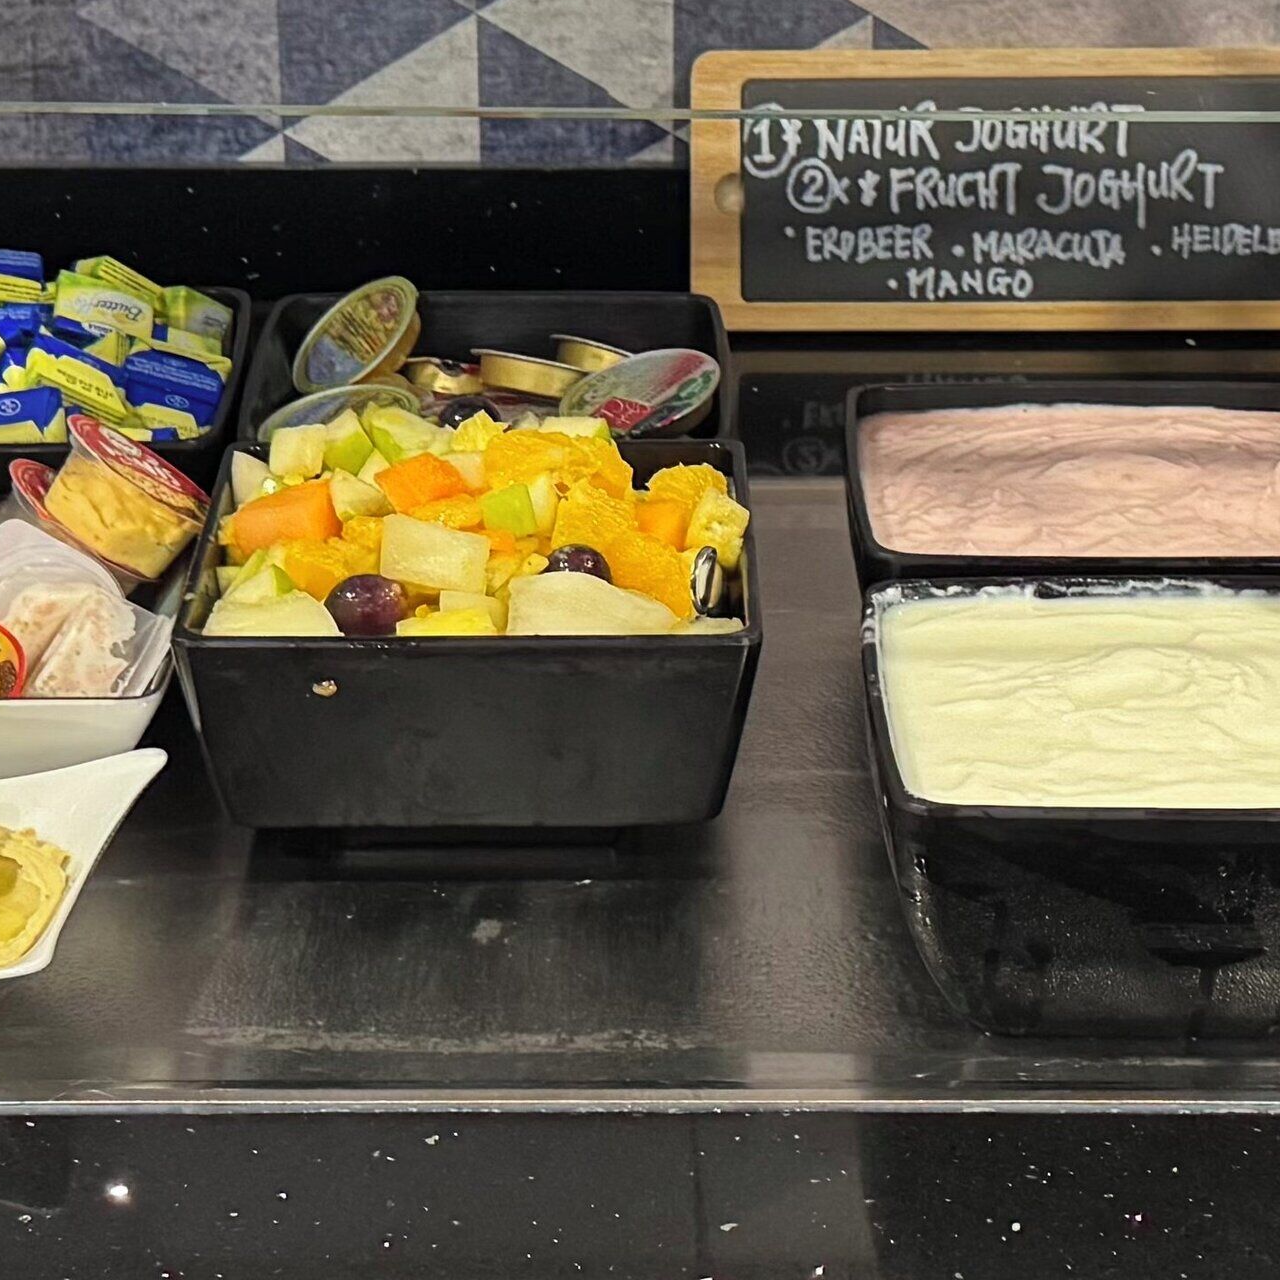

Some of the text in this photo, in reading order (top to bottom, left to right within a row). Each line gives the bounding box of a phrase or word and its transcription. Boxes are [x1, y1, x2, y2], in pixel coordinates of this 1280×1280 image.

[888, 162, 1022, 215] FRUCHT
[1035, 148, 1225, 230] JOGHURT
[804, 223, 934, 264] ERDBEER
[906, 266, 1034, 301] MANGO
